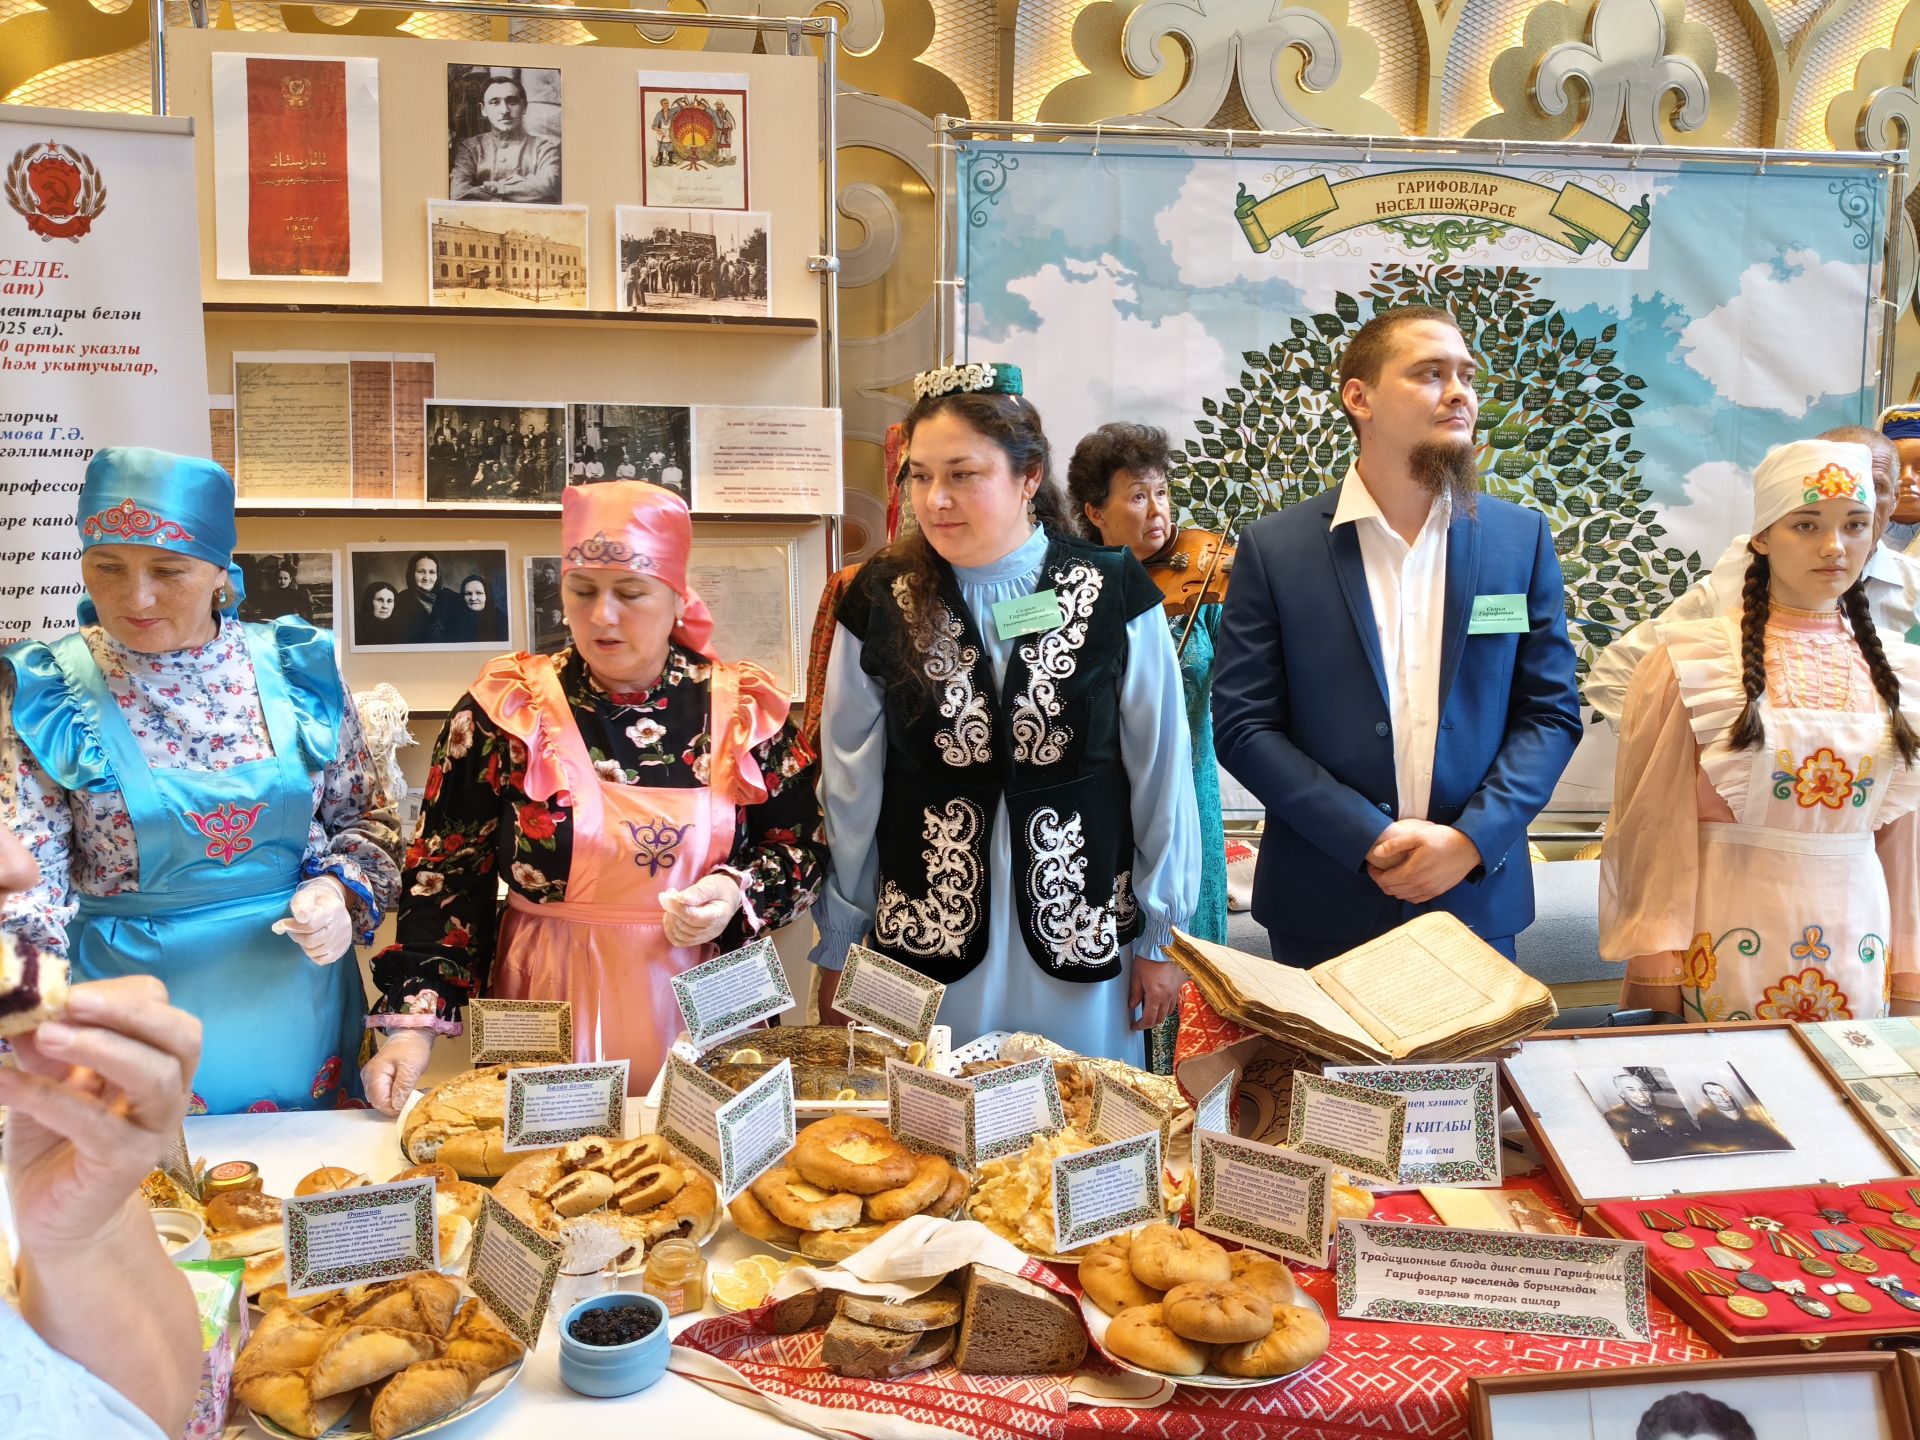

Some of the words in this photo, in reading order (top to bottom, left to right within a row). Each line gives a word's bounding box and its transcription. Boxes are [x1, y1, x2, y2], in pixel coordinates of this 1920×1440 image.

[1398, 180, 1498, 196] ГАРИФОВЛАР
[1375, 198, 1425, 213] НӘСЕЛ
[1429, 198, 1517, 218] ШӘҖӘРӘСЕ
[93, 306, 141, 321] белән
[32, 323, 63, 338] ел).
[15, 342, 75, 356] артык
[79, 342, 140, 357] указлы
[2, 357, 36, 370] һәм
[41, 359, 158, 375] укытучылар,
[43, 617, 75, 629] һәм
[1417, 1120, 1471, 1133] КИТАБЫ
[1426, 1146, 1454, 1154] басма
[1361, 1251, 1446, 1267] Традиционные
[1450, 1258, 1487, 1271] блюда
[1553, 1267, 1622, 1282] Гарифовых
[1385, 1269, 1457, 1284] Гарифовлар
[1461, 1276, 1519, 1288] нәселендә
[1523, 1280, 1596, 1294] борынгыдан
[1417, 1288, 1470, 1300] әзерләнә
[1474, 1293, 1517, 1305] торган
[1521, 1297, 1560, 1308] ашлар
